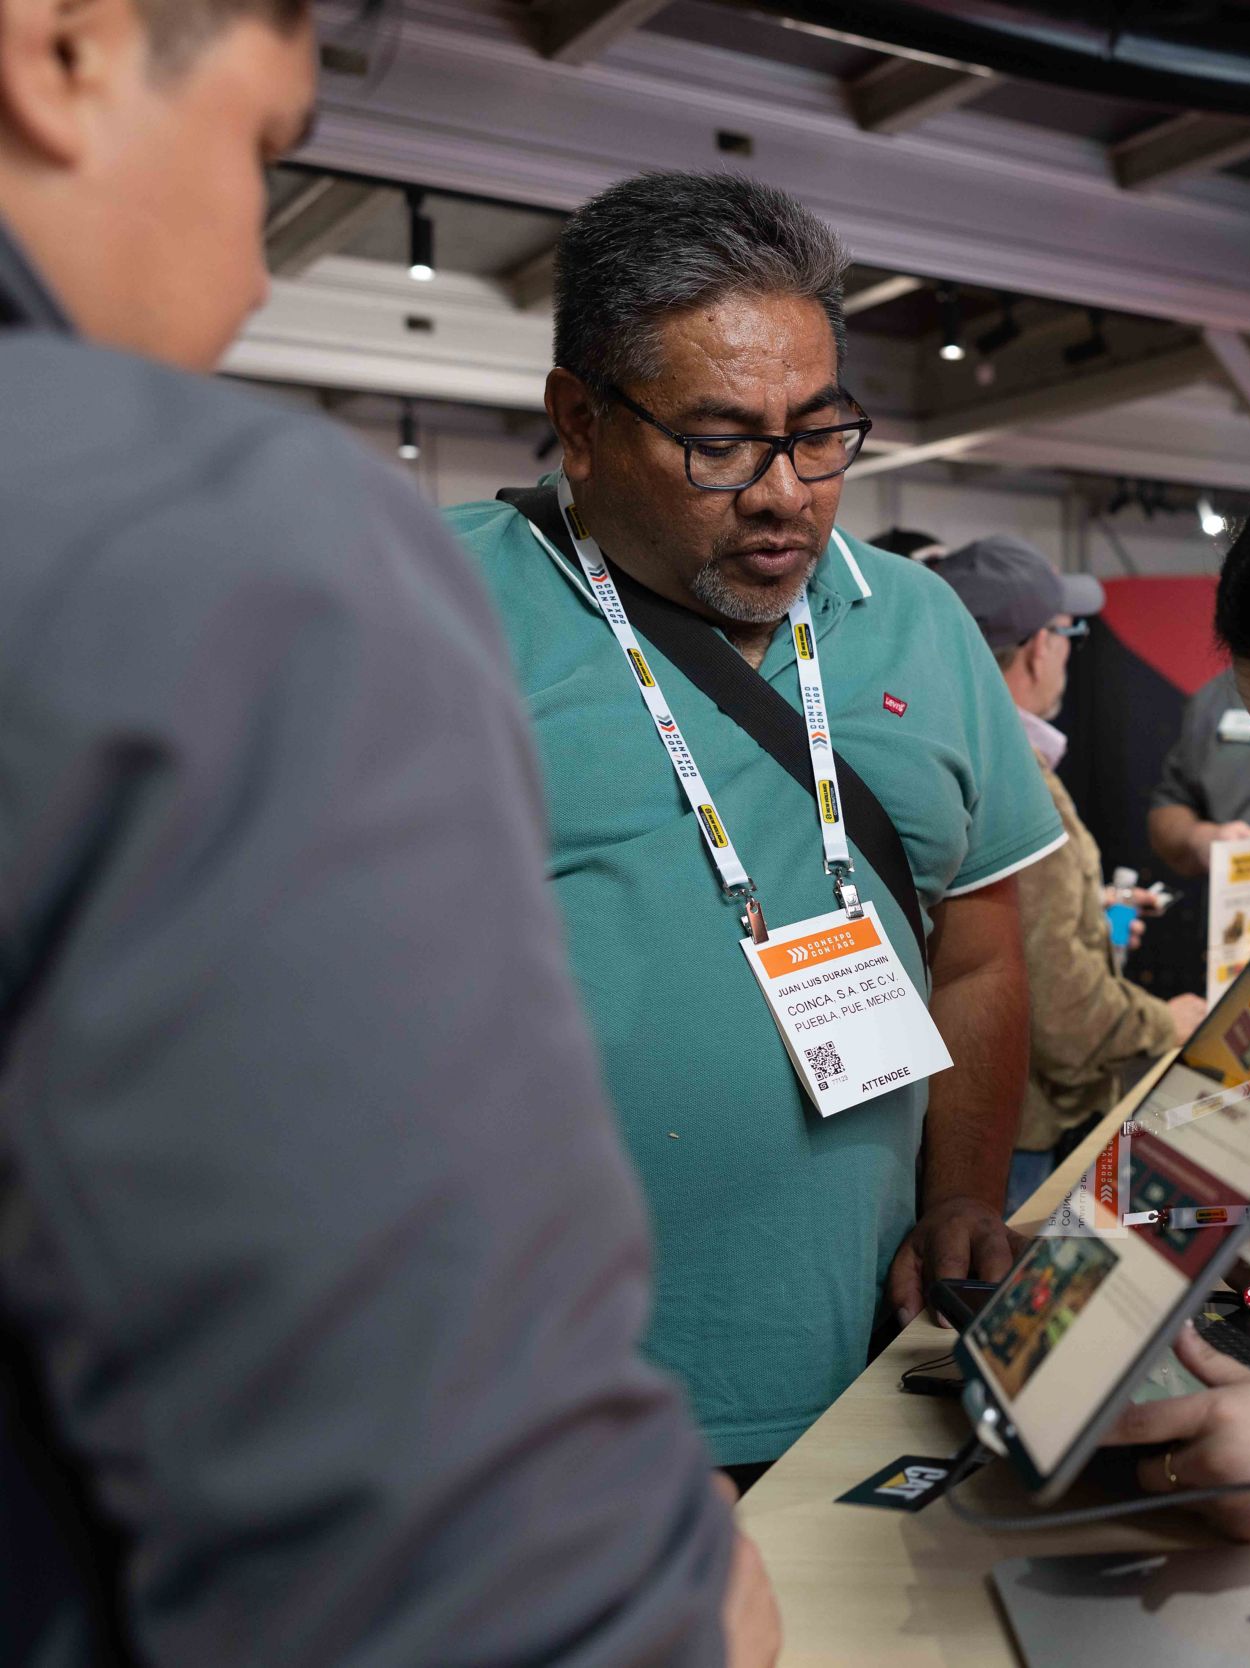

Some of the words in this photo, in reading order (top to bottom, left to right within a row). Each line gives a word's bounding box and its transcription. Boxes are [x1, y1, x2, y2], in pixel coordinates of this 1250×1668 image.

[596, 584, 619, 624] CON/AGG
[604, 583, 627, 625] CONEXPO
[804, 686, 817, 730] CONEXPO
[813, 686, 826, 730] CON/AGG
[665, 734, 690, 778] CON/AGG
[673, 733, 698, 777] CONEXPO
[807, 931, 852, 949] CONEXPO
[811, 939, 855, 958] CON/AGG
[778, 983, 801, 998] JUAN
[801, 976, 822, 990] LUIS
[822, 966, 853, 984] DURAN
[853, 955, 889, 974] JOACHIN
[787, 994, 836, 1017] COINCA,
[836, 986, 859, 1000] S.A.
[860, 978, 877, 993] DE
[877, 971, 899, 987] C.V.
[794, 1011, 841, 1033] PUEBLA,
[866, 987, 906, 1009] MEXICO
[861, 1066, 911, 1093] ATTENDEE
[874, 1466, 948, 1499] CAT
